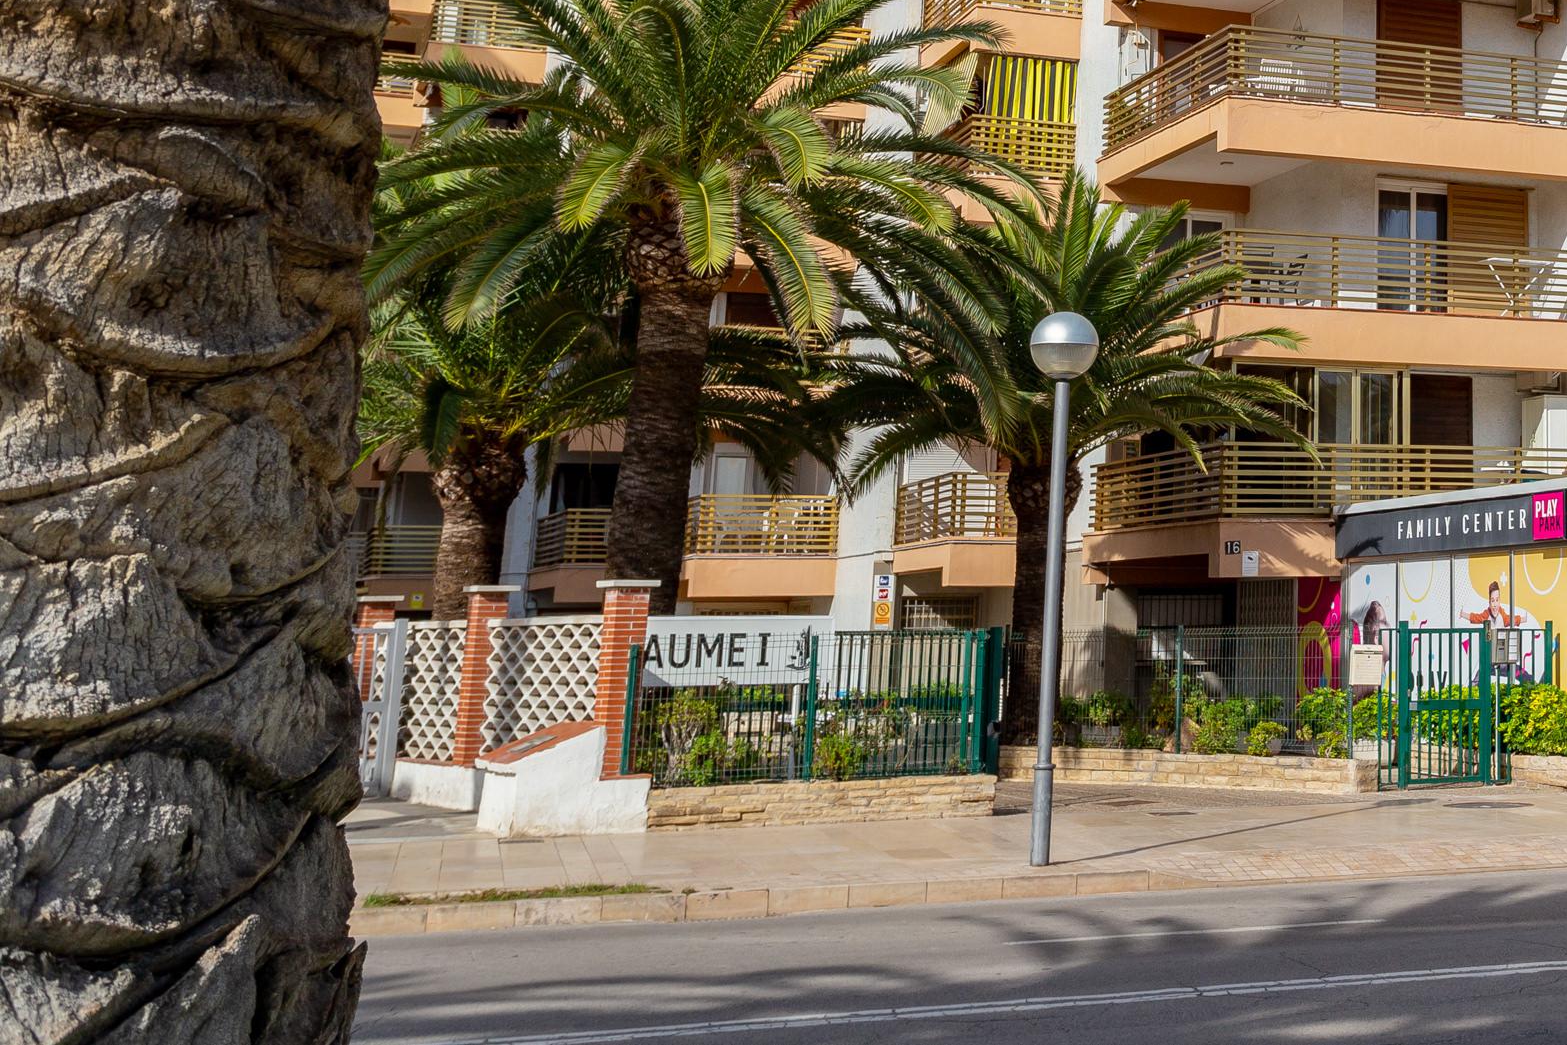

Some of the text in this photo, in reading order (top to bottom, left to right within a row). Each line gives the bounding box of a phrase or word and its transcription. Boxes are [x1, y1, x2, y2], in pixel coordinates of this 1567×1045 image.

[1535, 498, 1558, 518] PLAY
[1397, 508, 1527, 540] FAMILY CENTER
[1539, 515, 1561, 532] PARK
[1226, 541, 1240, 554] 16
[643, 632, 771, 668] AUME I
